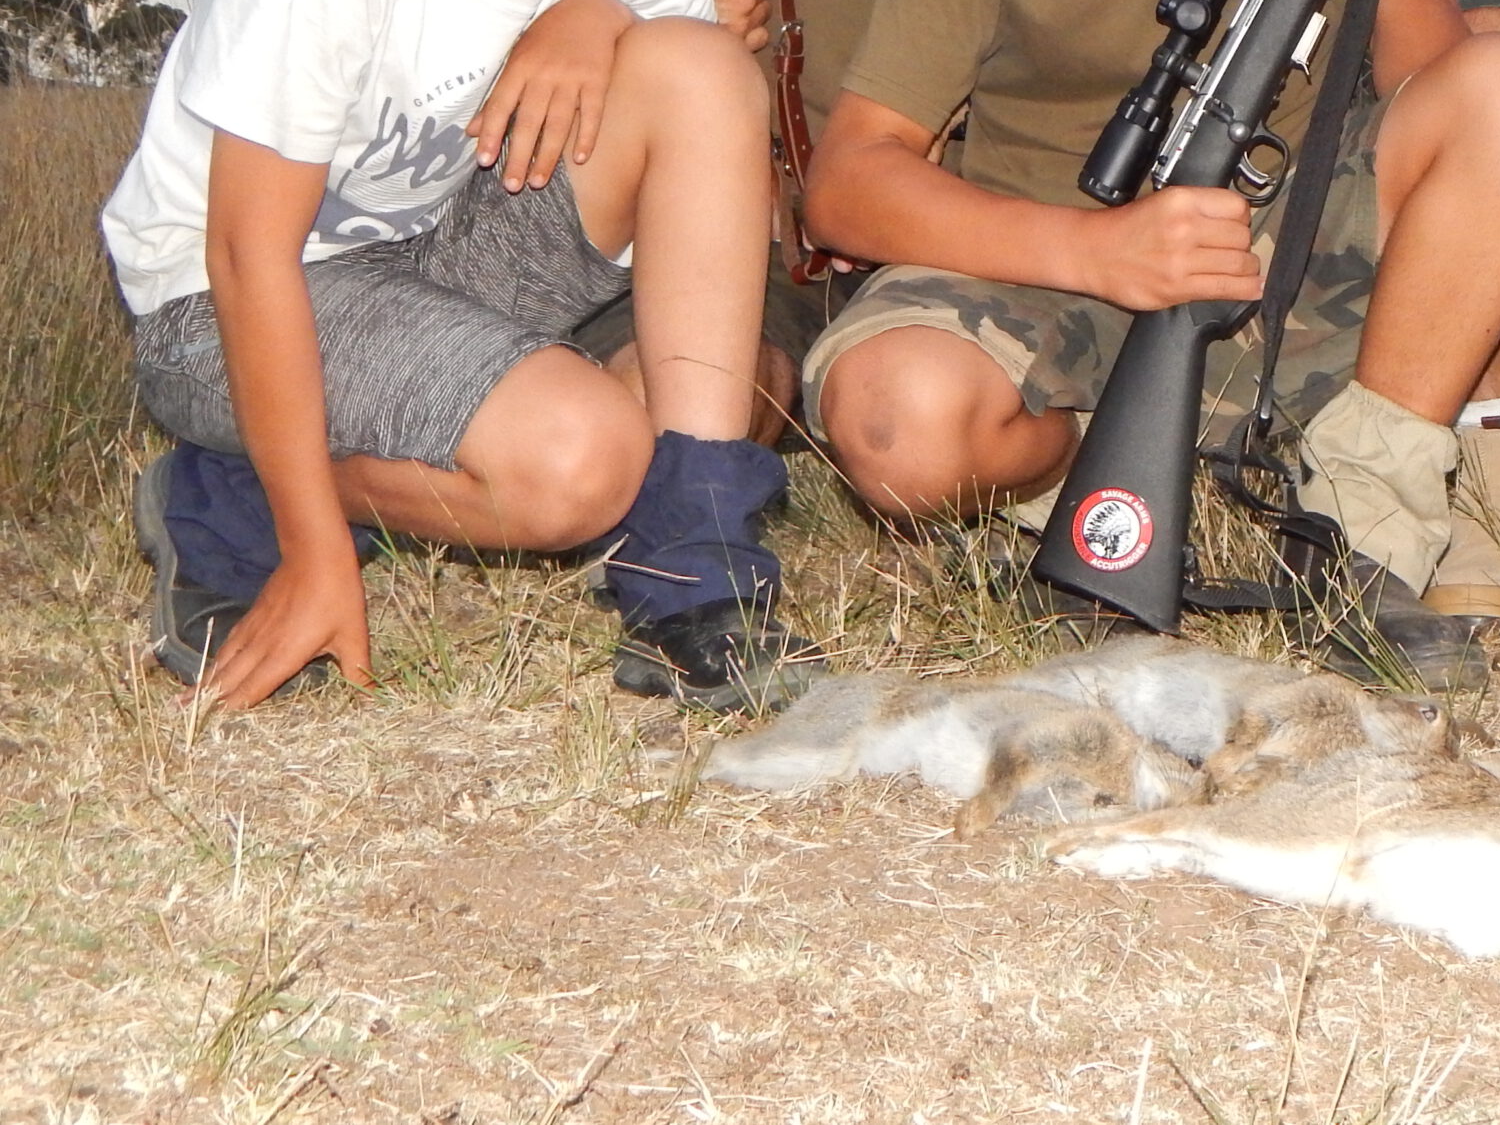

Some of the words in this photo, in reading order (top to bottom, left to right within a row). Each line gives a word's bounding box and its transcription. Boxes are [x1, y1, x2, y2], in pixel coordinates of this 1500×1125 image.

[413, 67, 487, 107] GATEWAY
[1101, 490, 1135, 503] SAVAGE
[1132, 501, 1151, 524] ARMS
[1089, 542, 1148, 570] ACCUTRIGGER
